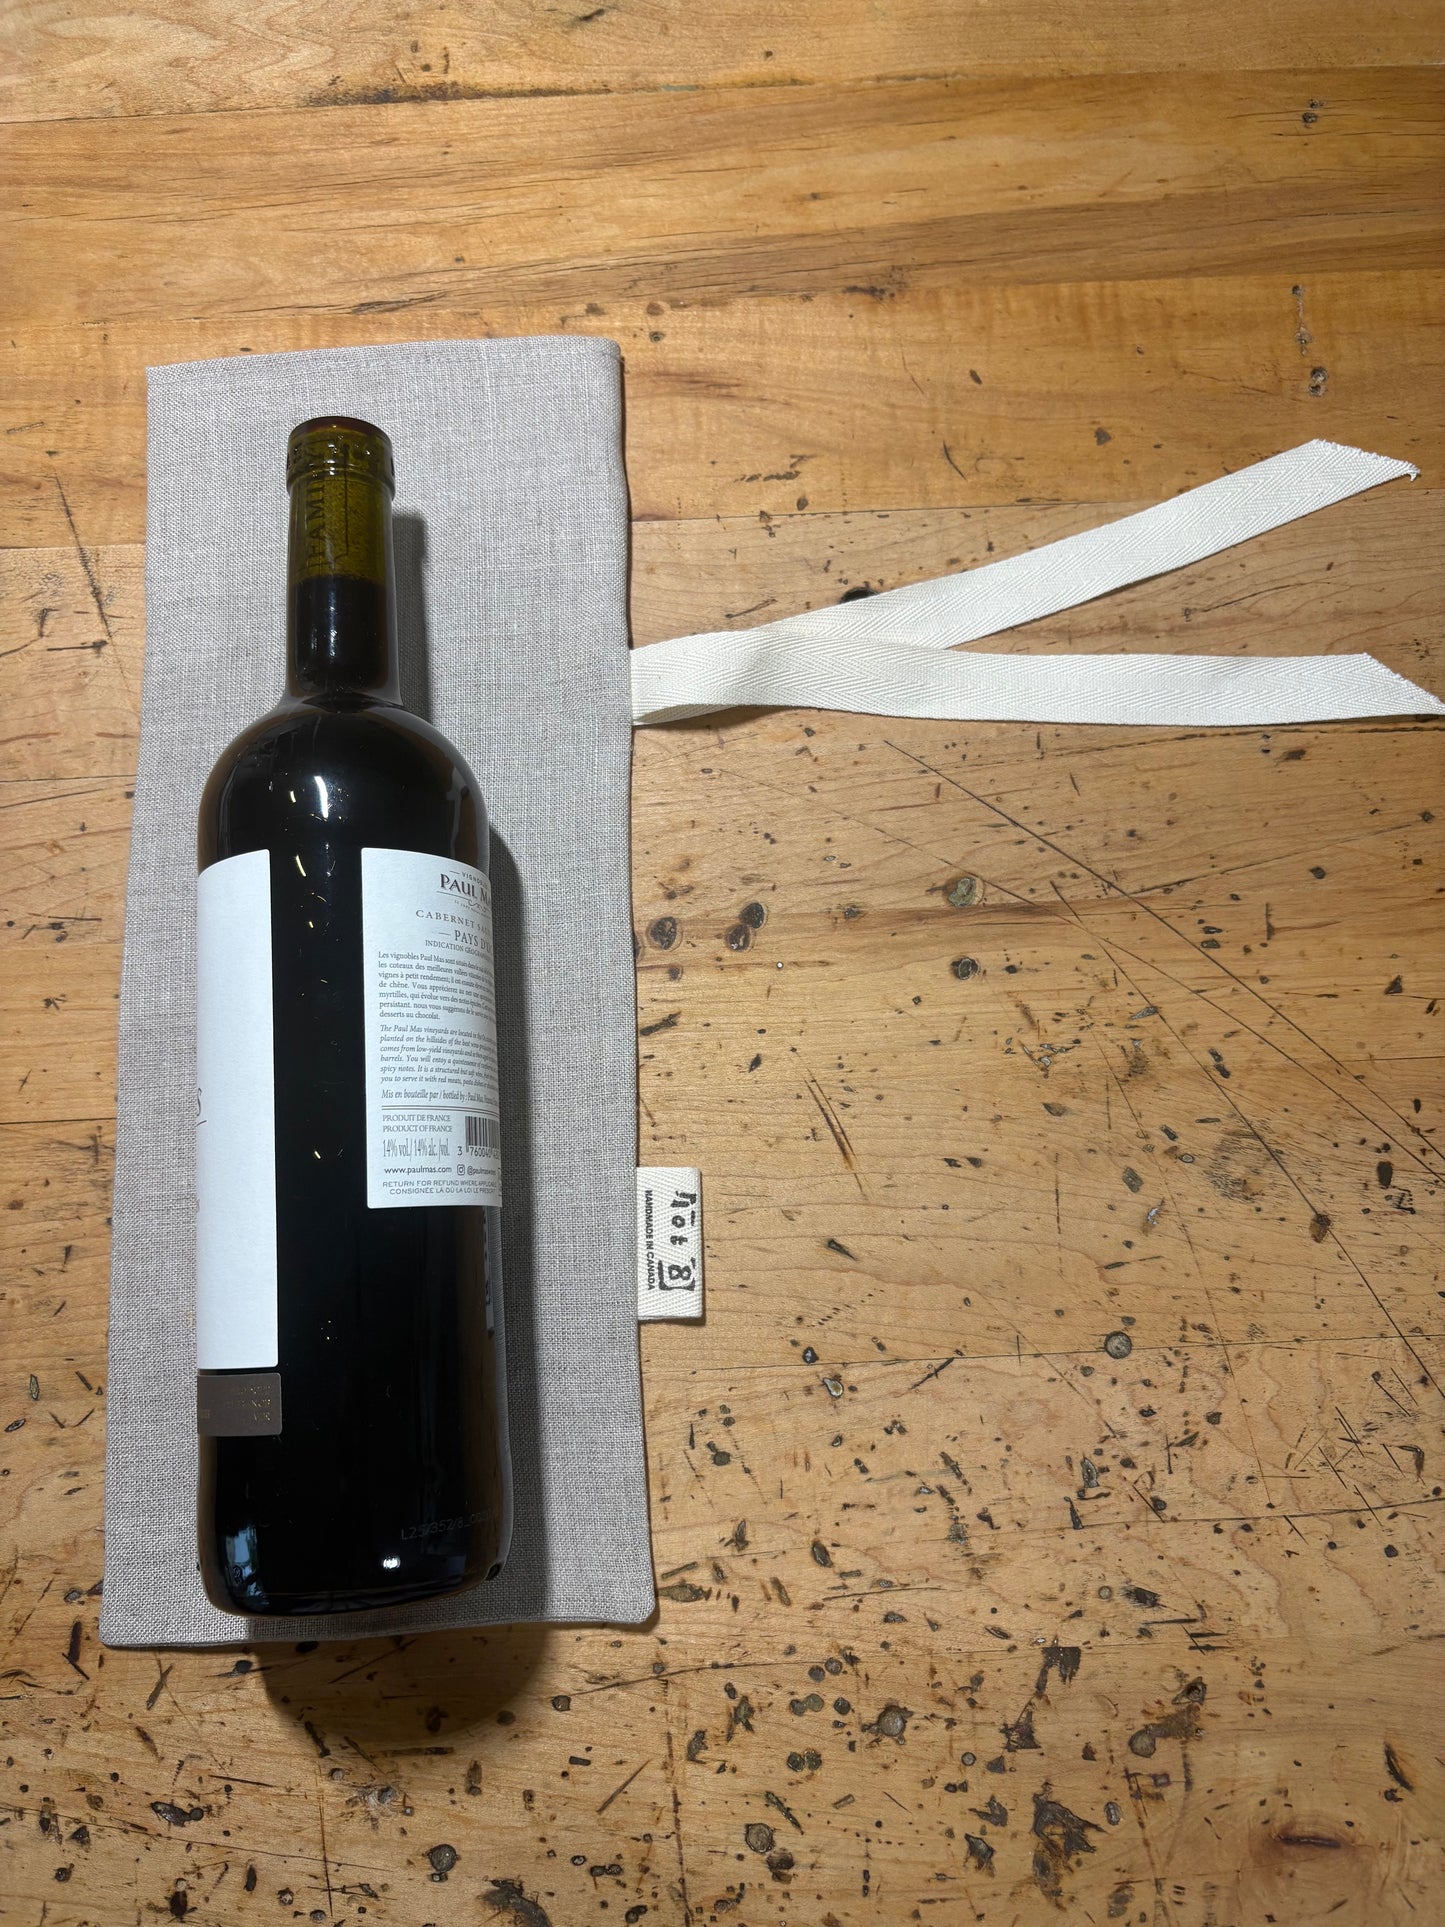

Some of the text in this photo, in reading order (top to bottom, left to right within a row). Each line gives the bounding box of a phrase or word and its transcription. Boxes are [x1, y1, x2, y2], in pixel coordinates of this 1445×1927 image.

[440, 873, 477, 899] PAUL
[415, 909, 475, 928] CABERNET
[454, 929, 479, 949] PAYS
[425, 940, 464, 952] INDICATION
[378, 951, 390, 959] Les
[390, 952, 419, 961] vignobles
[420, 954, 433, 962] Paul
[433, 955, 445, 963] Mas
[389, 962, 413, 970] coteaux
[427, 964, 453, 974] meilleures
[378, 972, 399, 980] vignes
[405, 973, 419, 981] petit
[389, 981, 409, 989] chêne.
[412, 982, 427, 990] Vous
[409, 993, 420, 1002] qui
[379, 1010, 405, 1018] desserts
[415, 1011, 440, 1020] chocolat.
[380, 1024, 391, 1032] The
[424, 1026, 449, 1036] vineyards
[380, 1034, 404, 1043] planted
[400, 1045, 415, 1054] from
[416, 1046, 441, 1055] low-yield
[380, 1065, 397, 1074] spicy
[424, 1075, 437, 1083] with
[381, 1089, 394, 1099] Mis
[403, 1089, 428, 1099] bouteille
[429, 1091, 439, 1101] par
[382, 1114, 451, 1122] PRODUIT DE FRANCE
[382, 1125, 452, 1133] PRODUCT OF FRANCE
[457, 1146, 463, 1156] 3
[383, 1165, 452, 1176] www.paulmas.com
[382, 1180, 415, 1188] RETURN
[433, 1179, 459, 1187] REFUND
[389, 1187, 434, 1195] CONSIGNÉE
[645, 1190, 656, 1291] HANDMADE IN CANADA
